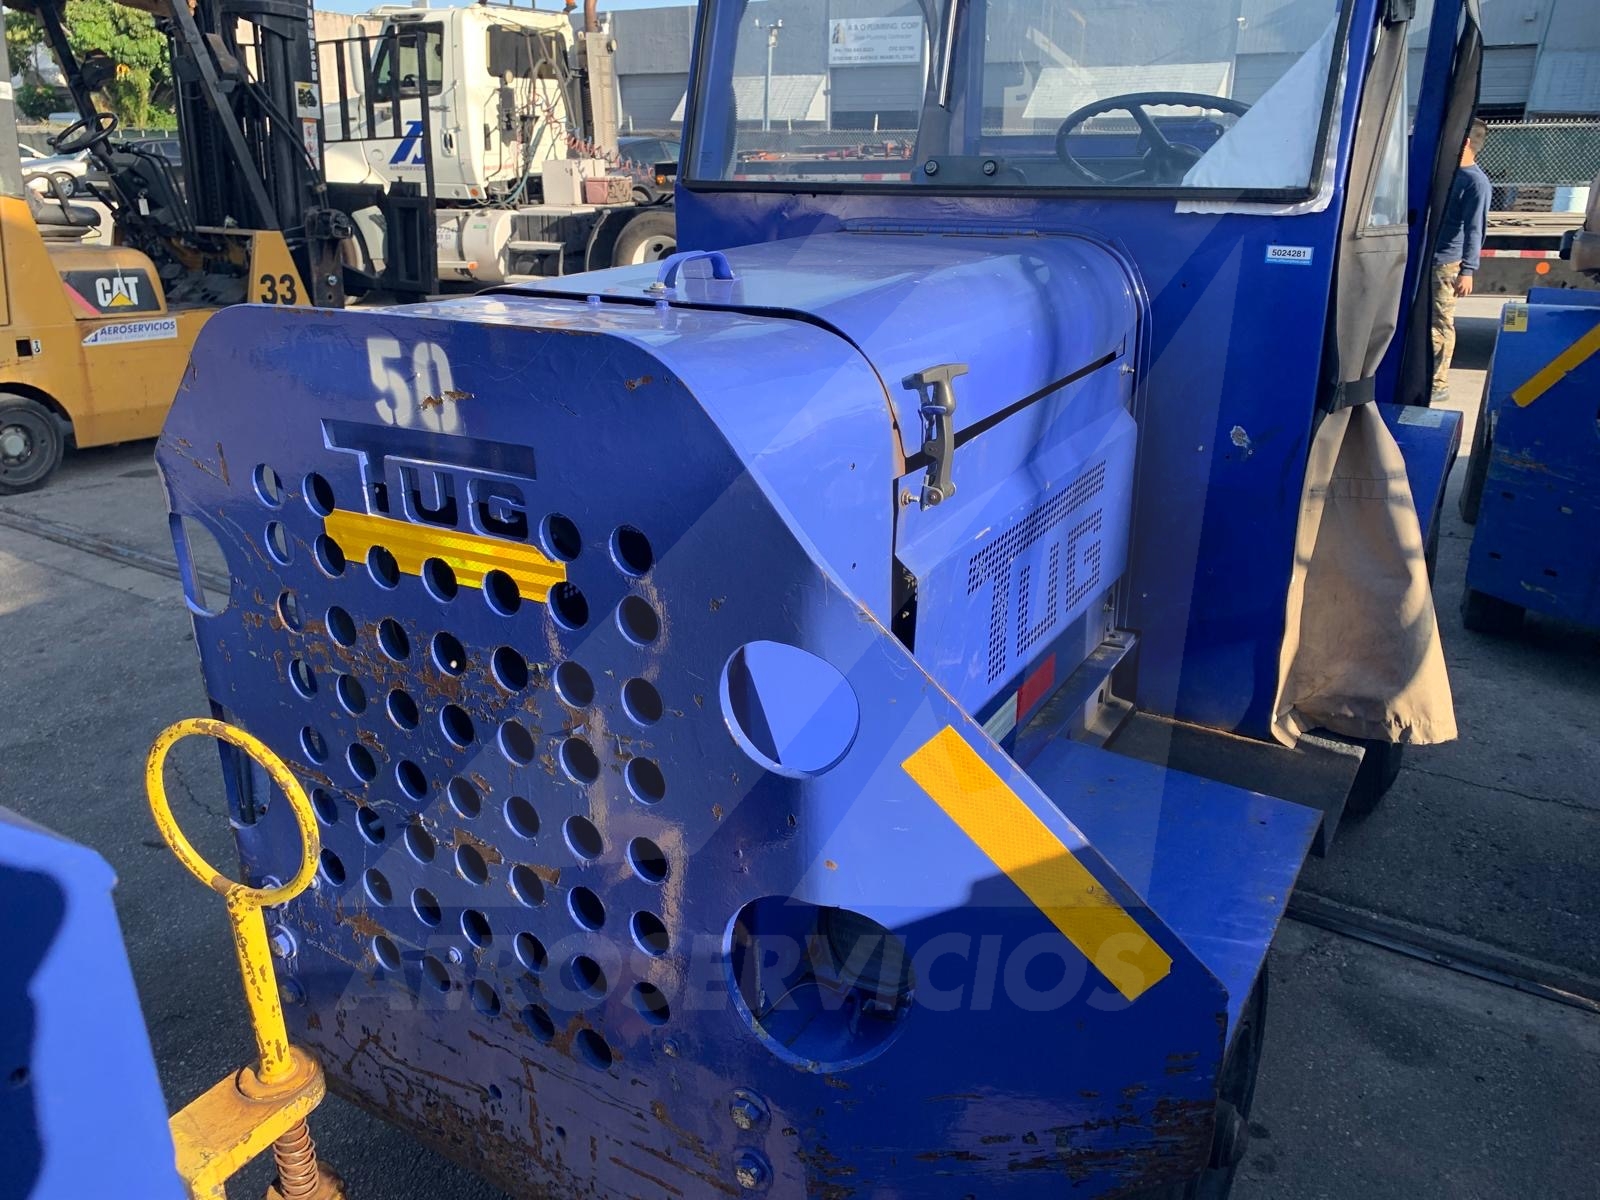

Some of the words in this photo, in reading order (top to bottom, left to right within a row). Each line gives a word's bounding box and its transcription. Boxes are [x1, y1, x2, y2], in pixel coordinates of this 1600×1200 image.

[1271, 249, 1306, 258] 5024281
[95, 276, 139, 307] CAT
[260, 274, 297, 305] 33
[100, 321, 175, 335] AEROSERVICIOS
[366, 337, 459, 433] 50
[320, 418, 537, 542] TUG
[967, 459, 1107, 685] TUG
